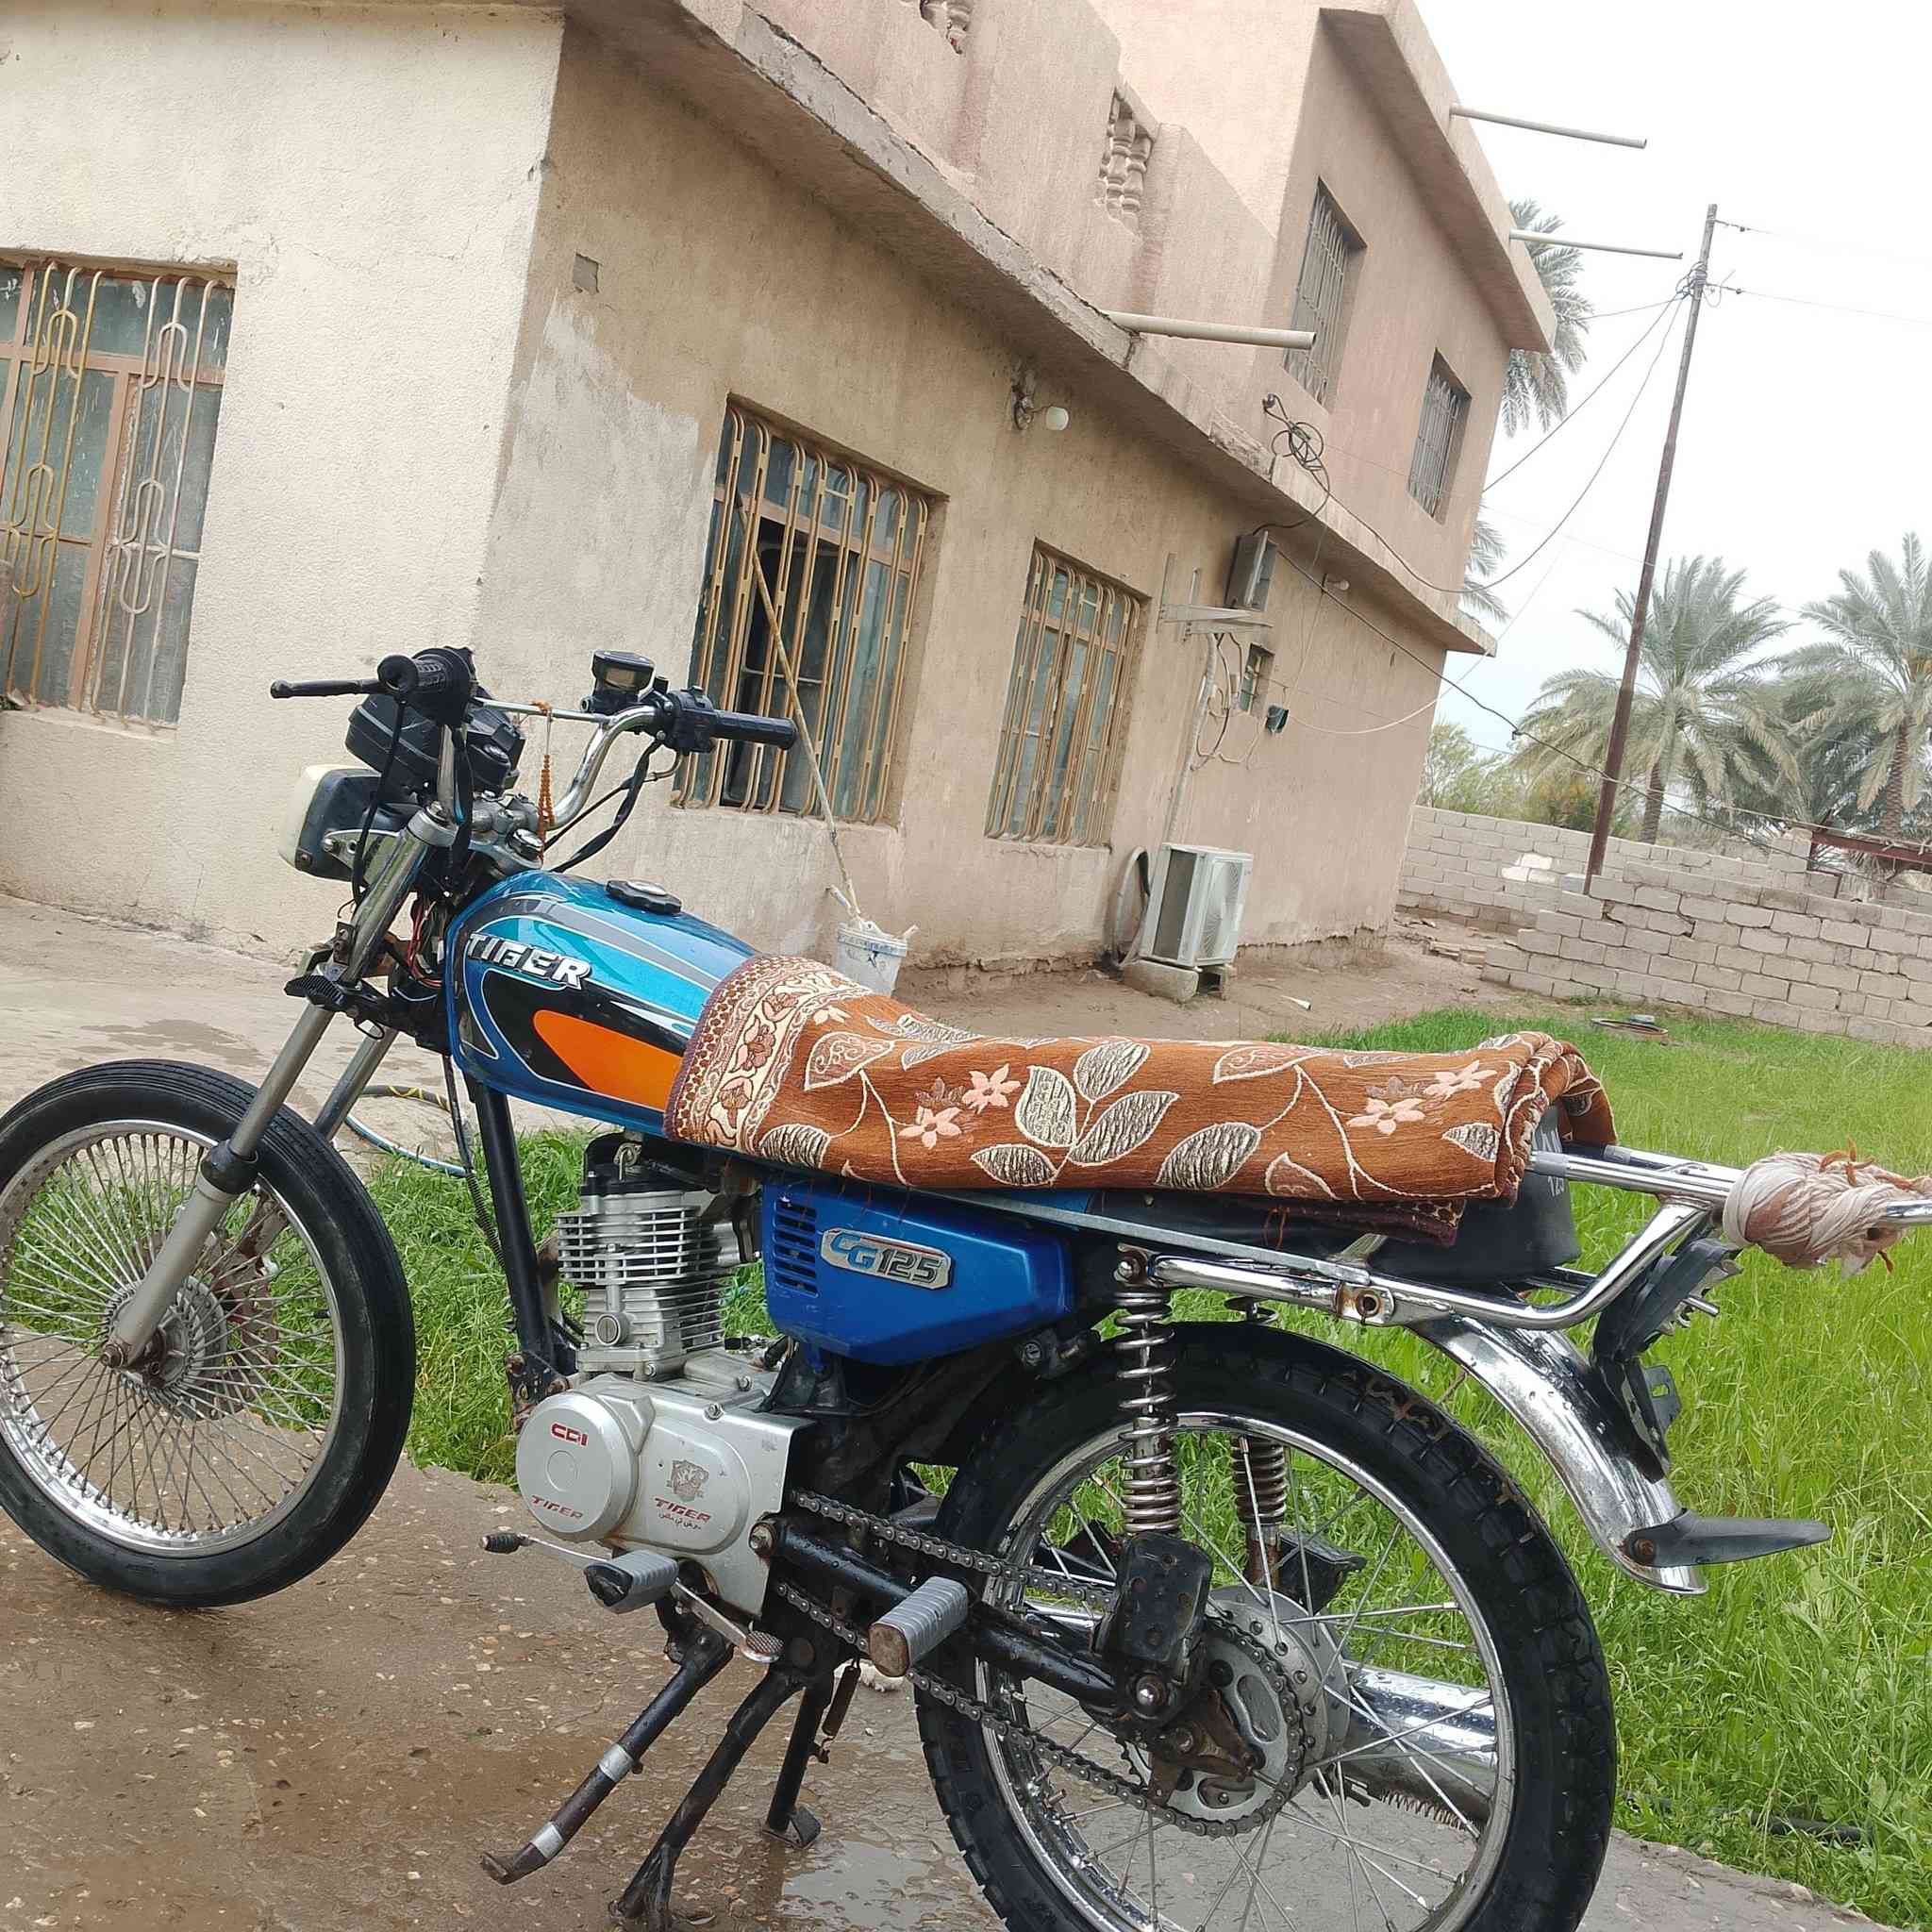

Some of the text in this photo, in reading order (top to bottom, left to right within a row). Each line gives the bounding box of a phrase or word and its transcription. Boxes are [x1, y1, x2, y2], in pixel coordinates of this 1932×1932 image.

[467, 933, 591, 990] TIGER
[829, 1233, 941, 1284] CG125
[551, 1423, 589, 1446] CDI
[531, 1495, 584, 1520] TIGER
[654, 1498, 713, 1523] TIGER
